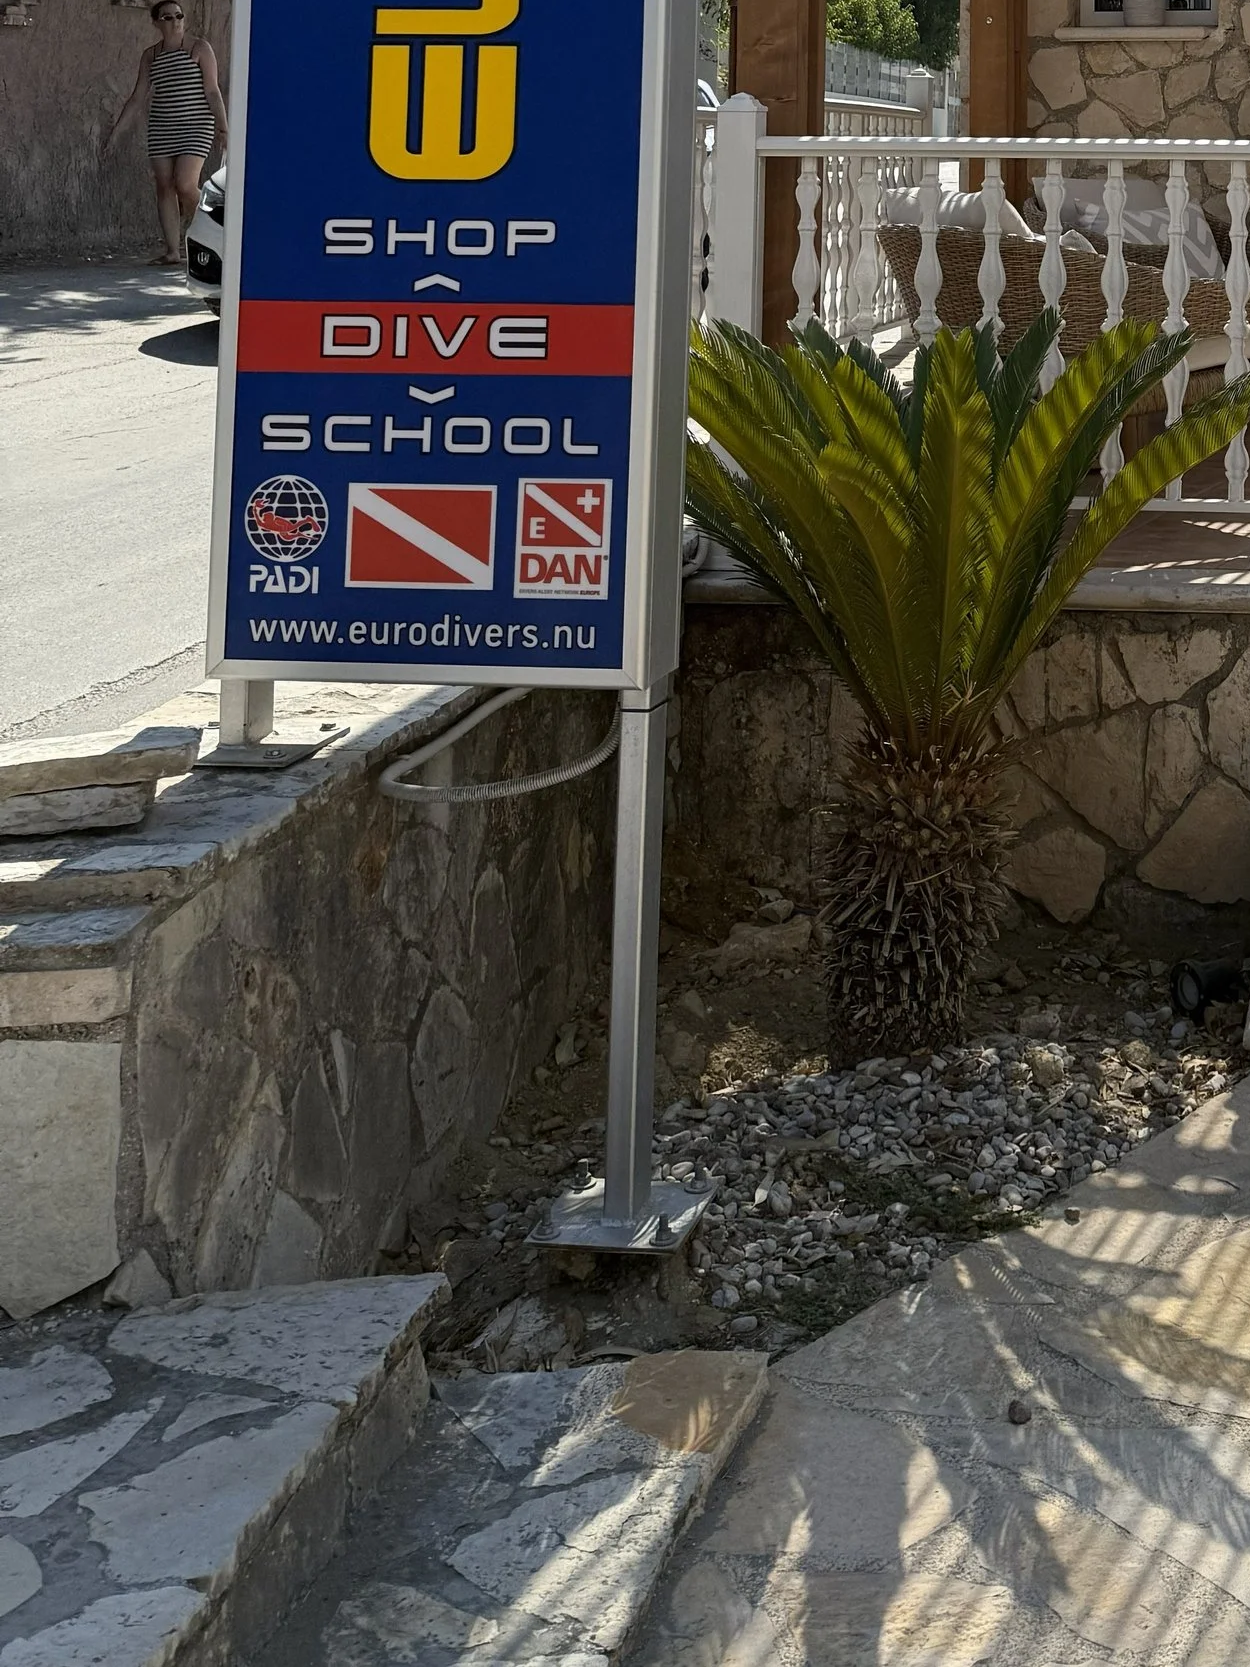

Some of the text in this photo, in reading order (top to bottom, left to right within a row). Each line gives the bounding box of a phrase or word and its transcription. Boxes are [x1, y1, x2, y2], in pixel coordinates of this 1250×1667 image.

[324, 218, 557, 256] SHOP
[322, 315, 548, 358] DIVE
[262, 414, 599, 455] SCHOOL
[529, 517, 546, 539] E
[249, 564, 319, 594] PADI
[519, 553, 602, 585] DAN
[249, 613, 596, 650] www.eurodivers.nu
